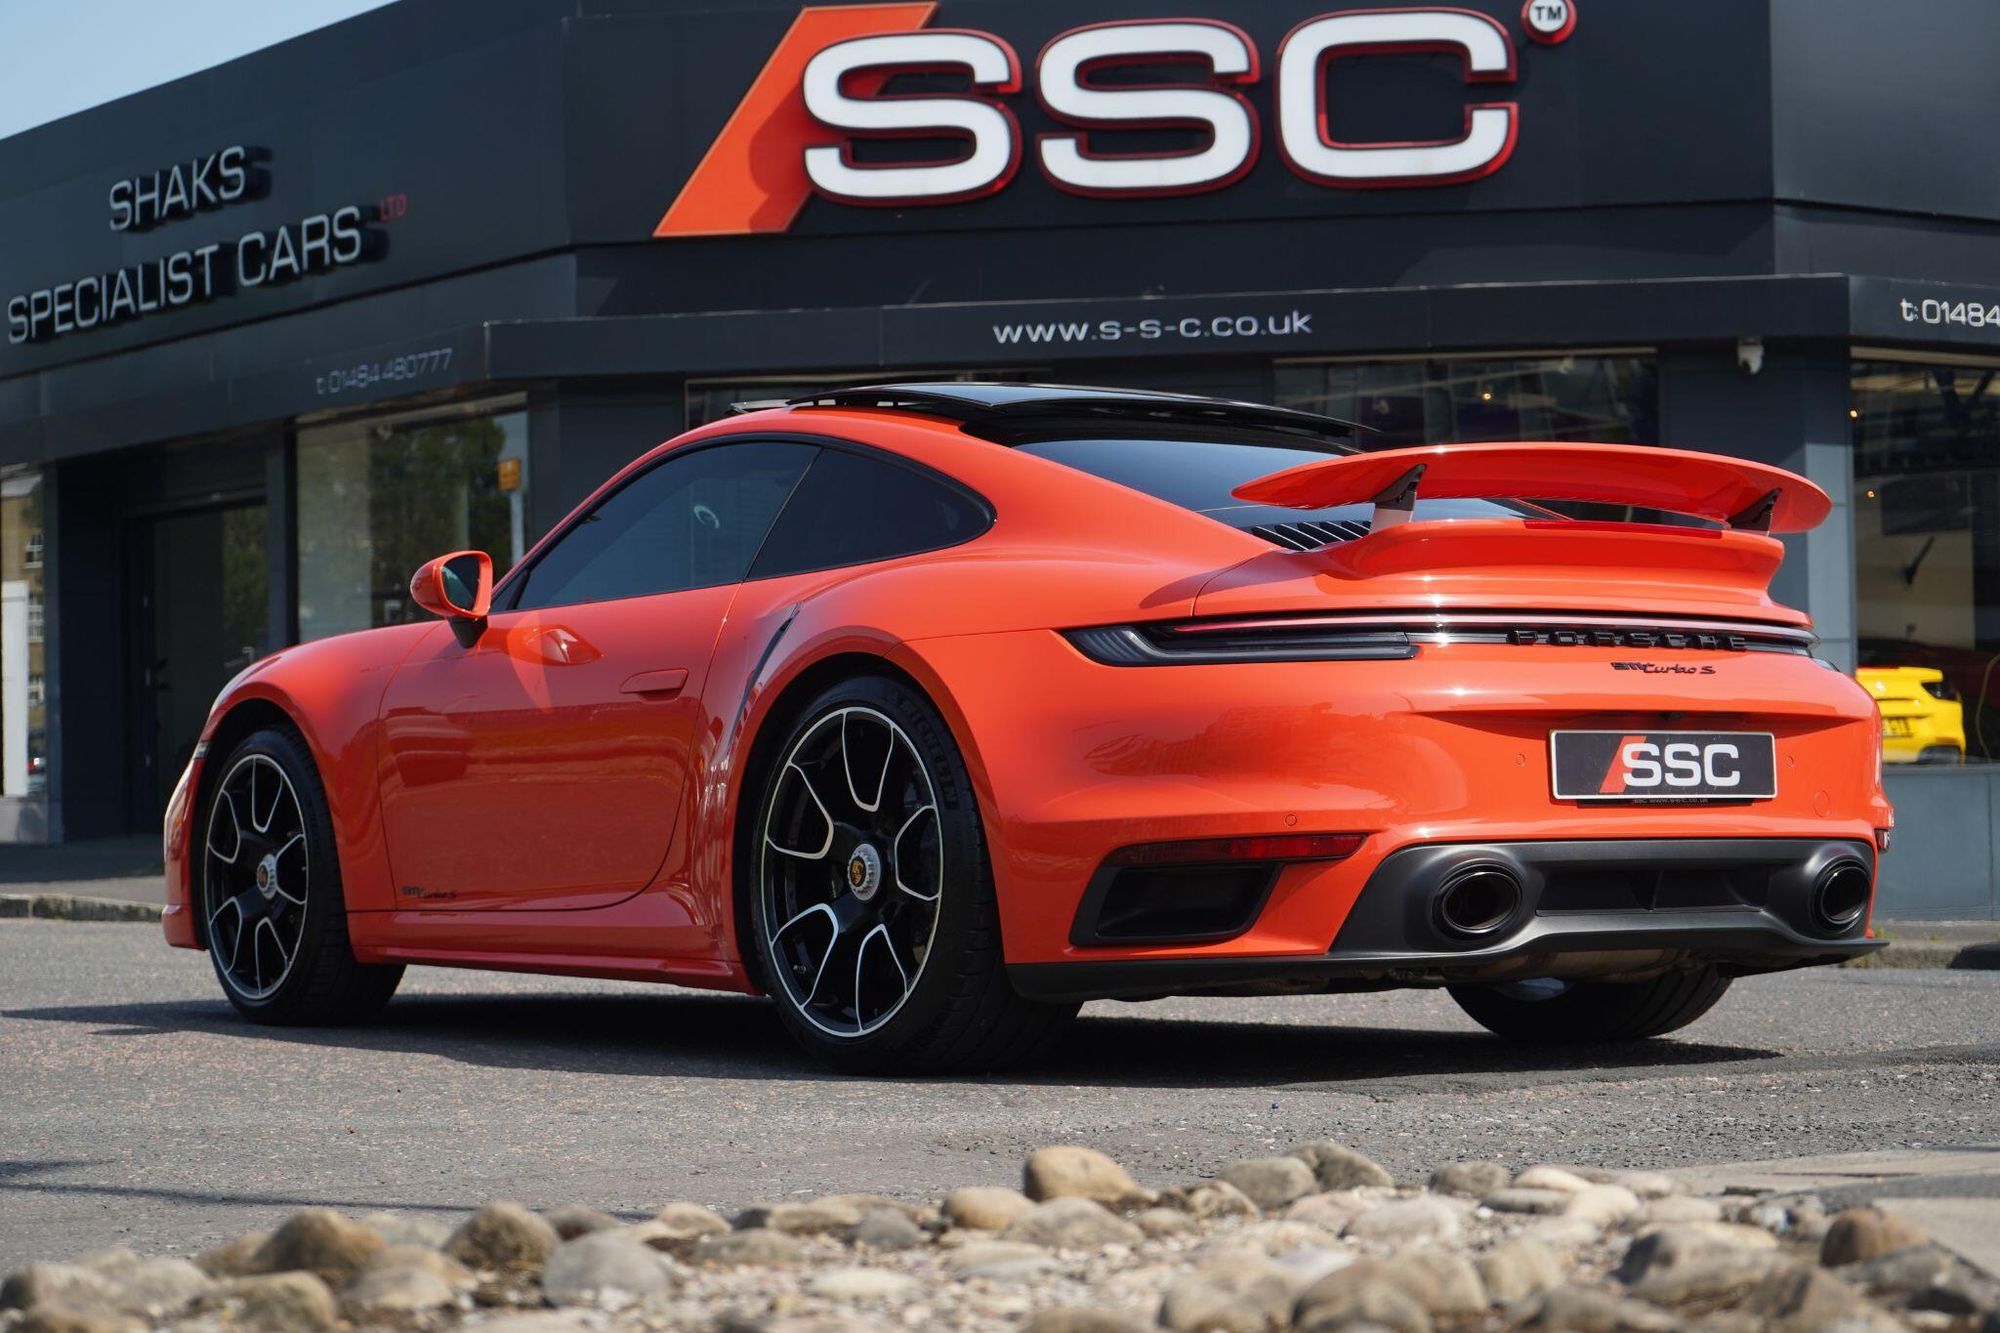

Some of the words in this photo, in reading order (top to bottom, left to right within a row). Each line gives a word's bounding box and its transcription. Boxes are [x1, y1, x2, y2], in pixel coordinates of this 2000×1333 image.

[1534, 5, 1562, 20] TM
[801, 8, 1520, 204] SSC
[109, 145, 246, 231] SHAKS
[7, 243, 219, 344] SPECIALIST
[237, 205, 362, 287] CARS
[379, 193, 407, 221] LTD
[992, 310, 1313, 344] www.s-s-c.co.uk
[1508, 630, 1747, 651] PORSCHE
[1622, 742, 1741, 787] SSC
